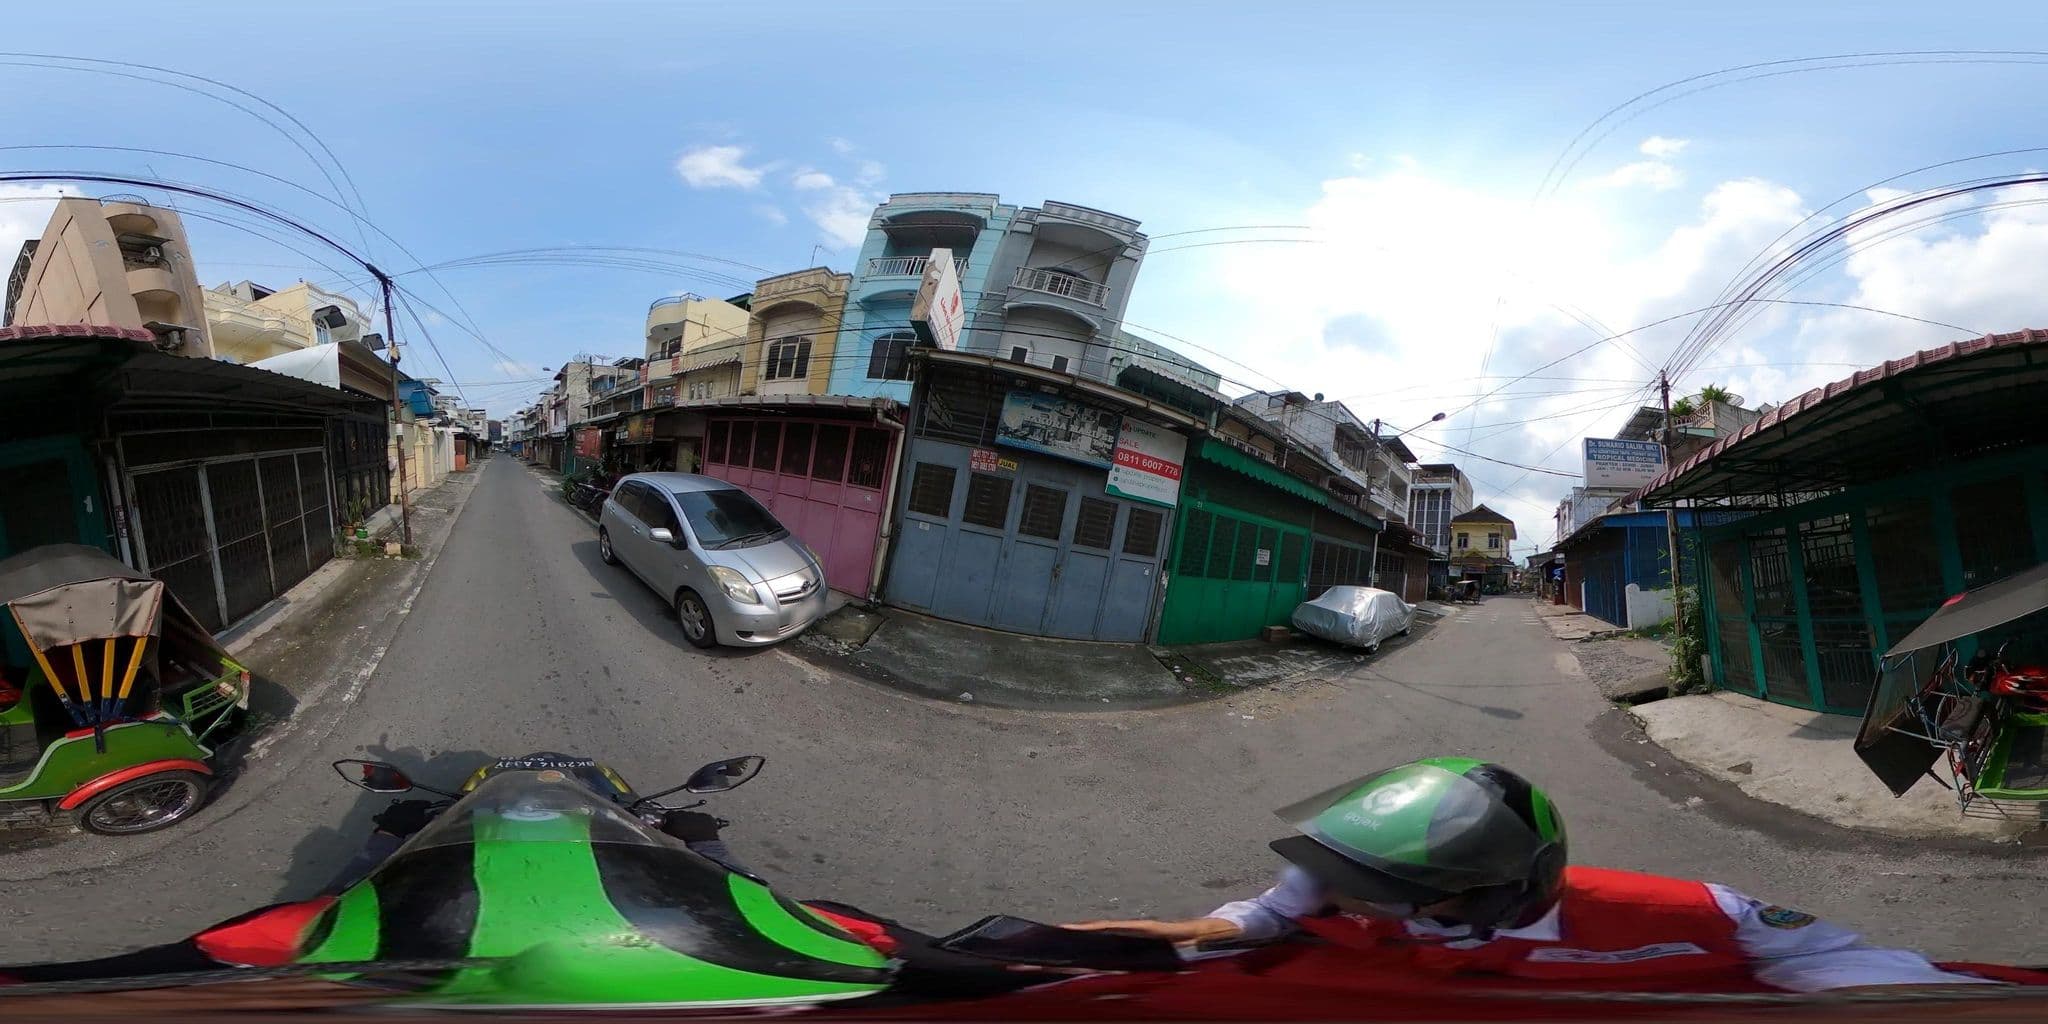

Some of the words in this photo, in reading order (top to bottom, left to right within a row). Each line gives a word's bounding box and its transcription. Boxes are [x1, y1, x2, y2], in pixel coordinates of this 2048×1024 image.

[1119, 437, 1139, 449] SALE
[999, 459, 1016, 469] JUAL
[1118, 451, 1140, 465] 0811
[1141, 458, 1163, 471] 6007
